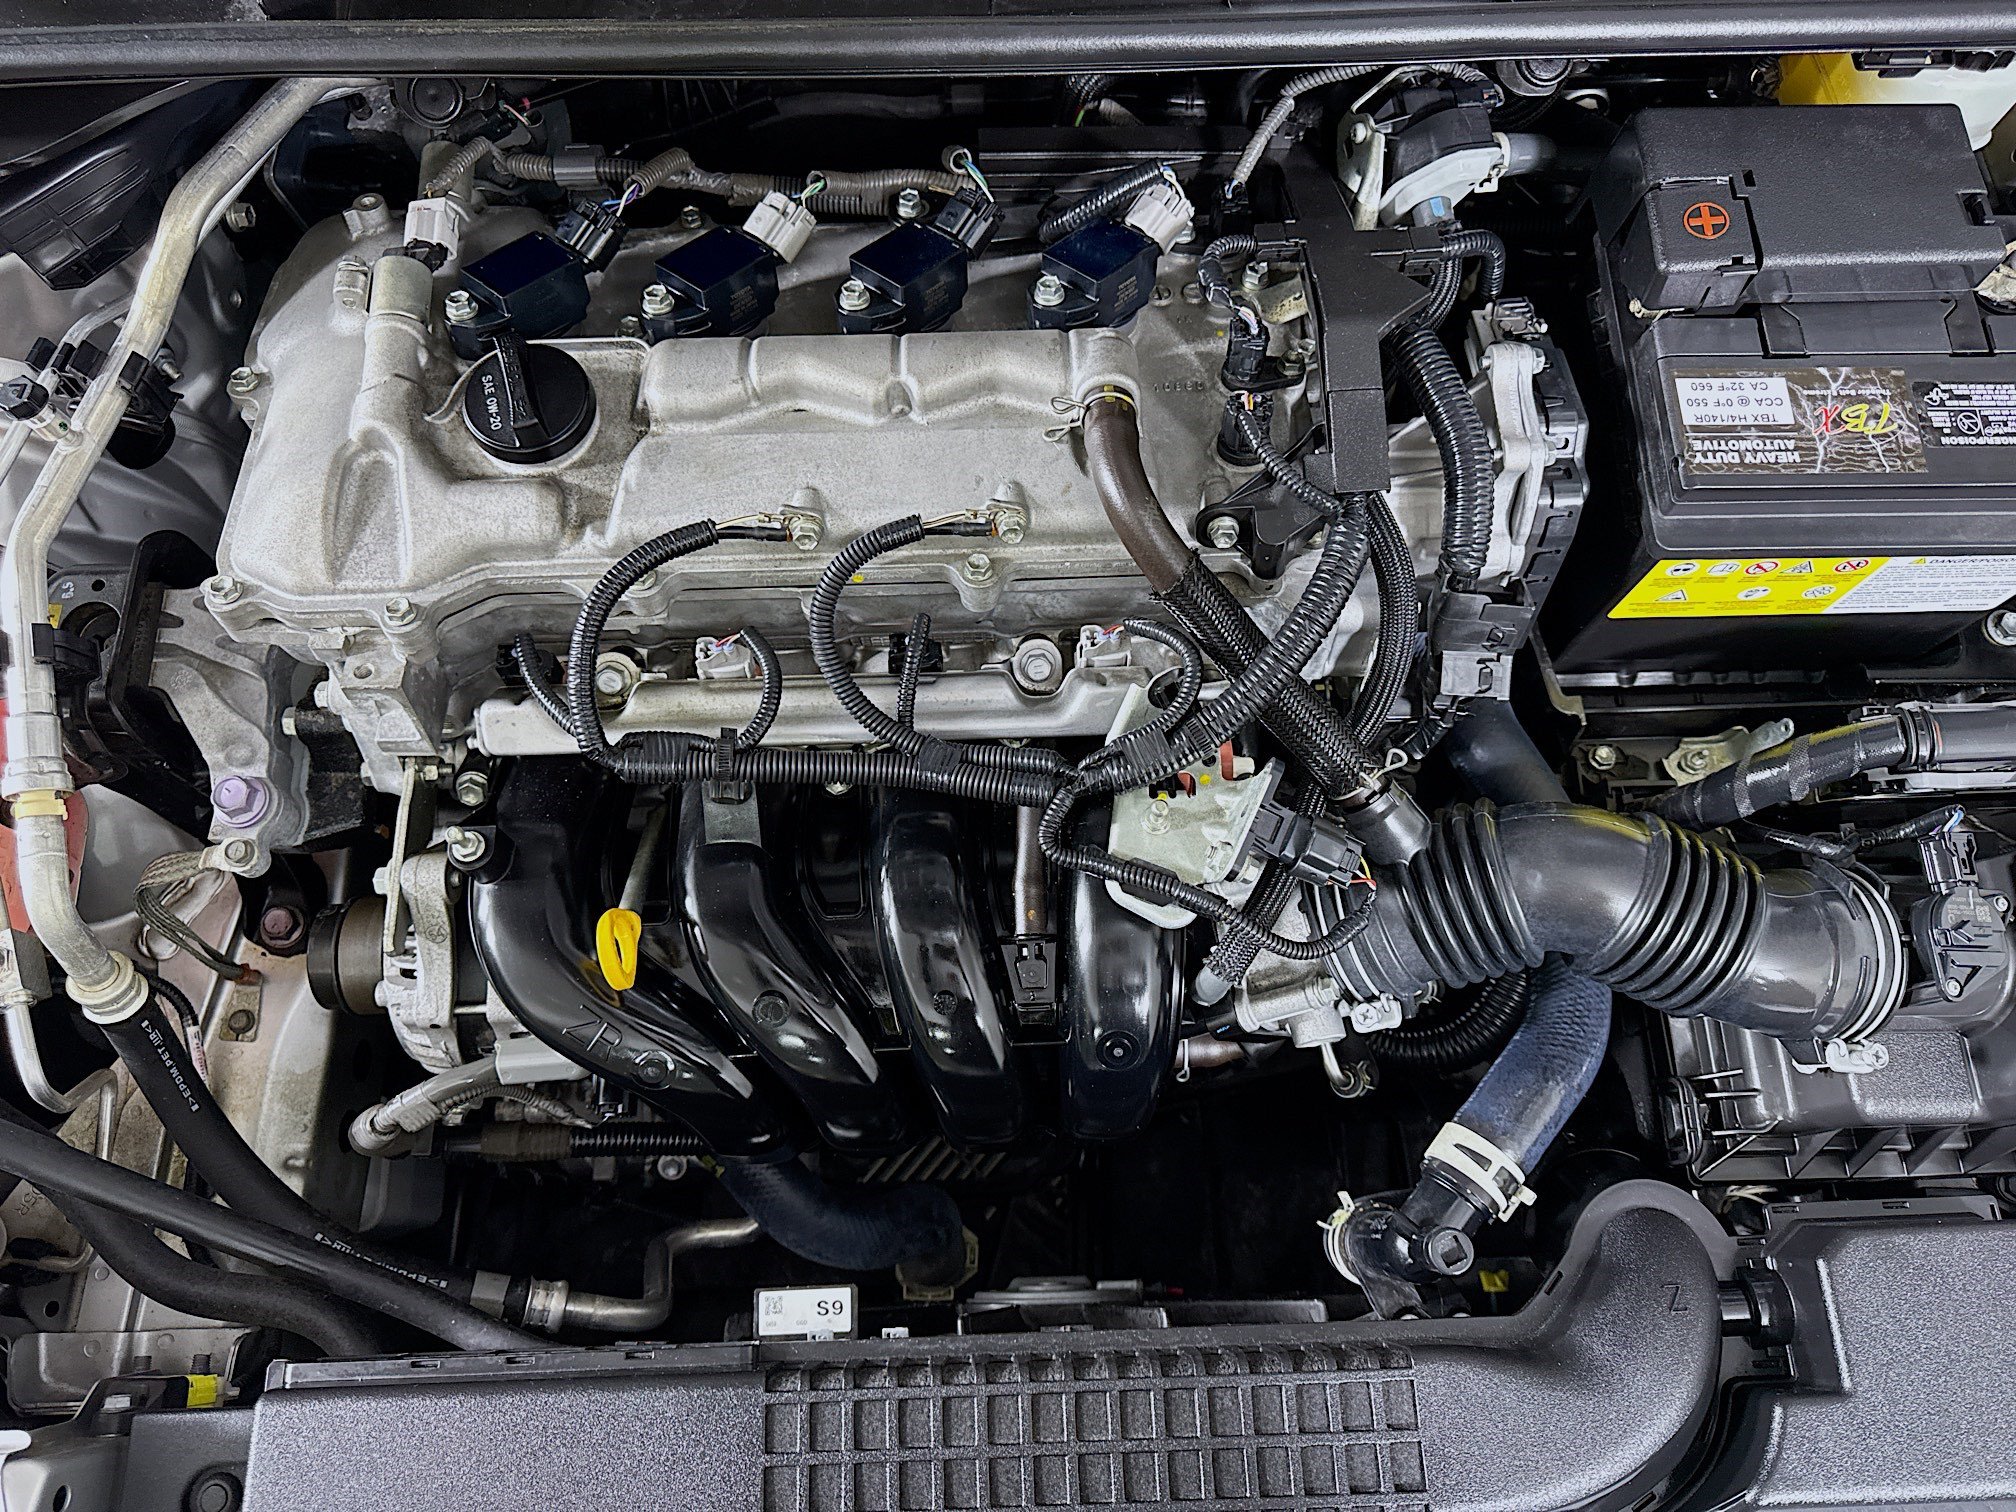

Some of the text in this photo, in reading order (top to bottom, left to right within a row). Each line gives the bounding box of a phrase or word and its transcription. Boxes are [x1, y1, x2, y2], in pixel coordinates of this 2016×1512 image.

[1690, 382, 1714, 391] 660
[1749, 381, 1769, 391] CA
[481, 374, 503, 431] SAE 0W-20
[1686, 398, 1709, 407] 550
[1737, 395, 1751, 407] @
[1755, 397, 1784, 407] CCA
[1694, 413, 1780, 423] TBX H4/140R
[1812, 402, 1898, 436] TBX
[1692, 438, 1796, 451] AUTOMOTIVE
[1693, 450, 1802, 464] HEAVY DUTY
[561, 1004, 623, 1061] ZR
[1660, 1283, 1688, 1314] Z
[816, 1299, 844, 1317] S9
